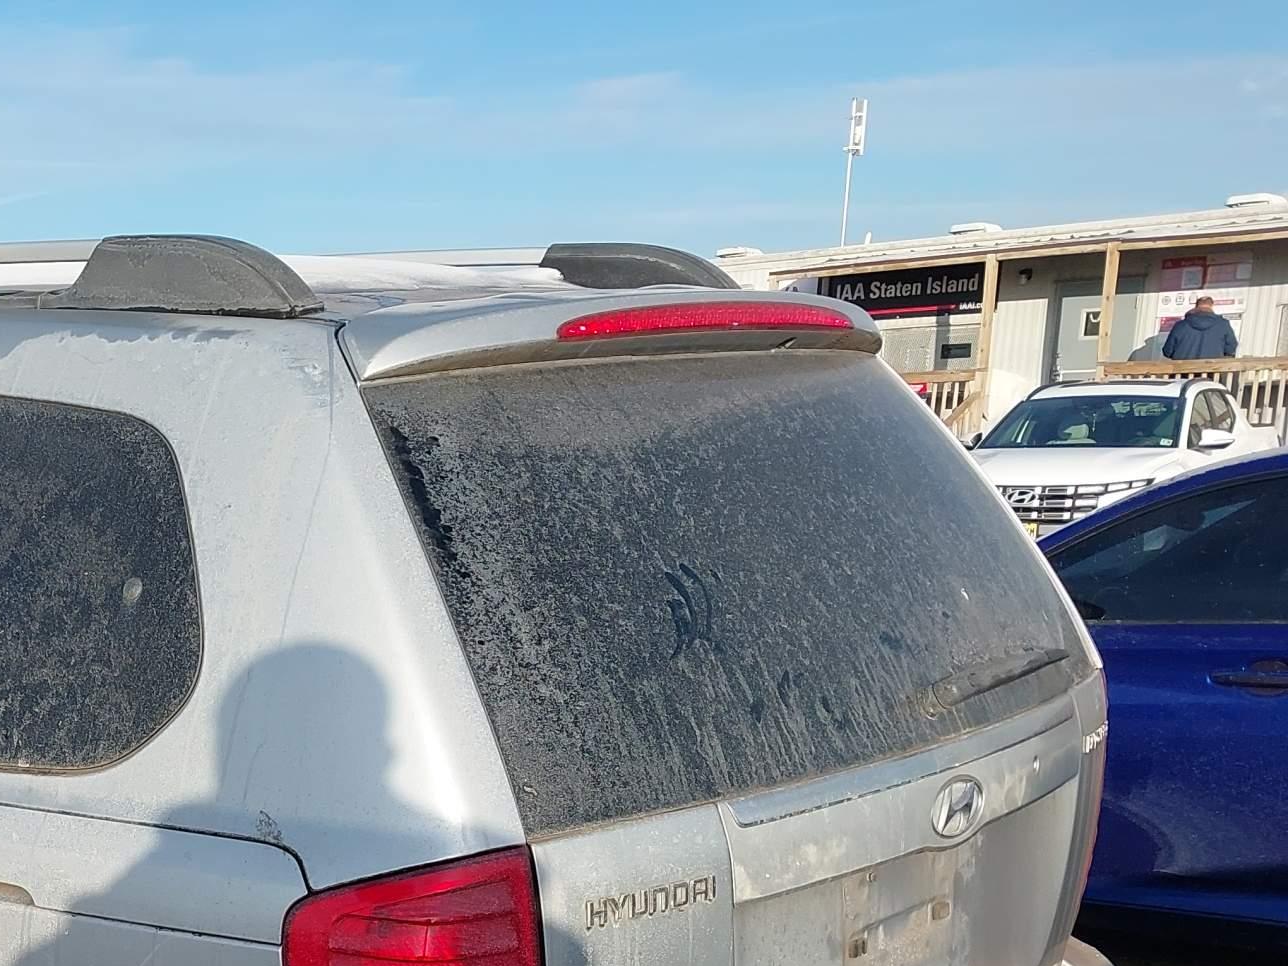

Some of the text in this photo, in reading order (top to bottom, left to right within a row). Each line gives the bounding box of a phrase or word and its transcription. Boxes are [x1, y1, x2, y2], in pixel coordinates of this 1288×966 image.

[836, 273, 979, 301] IAA Staten Island
[585, 875, 716, 930] HYUNDAI
